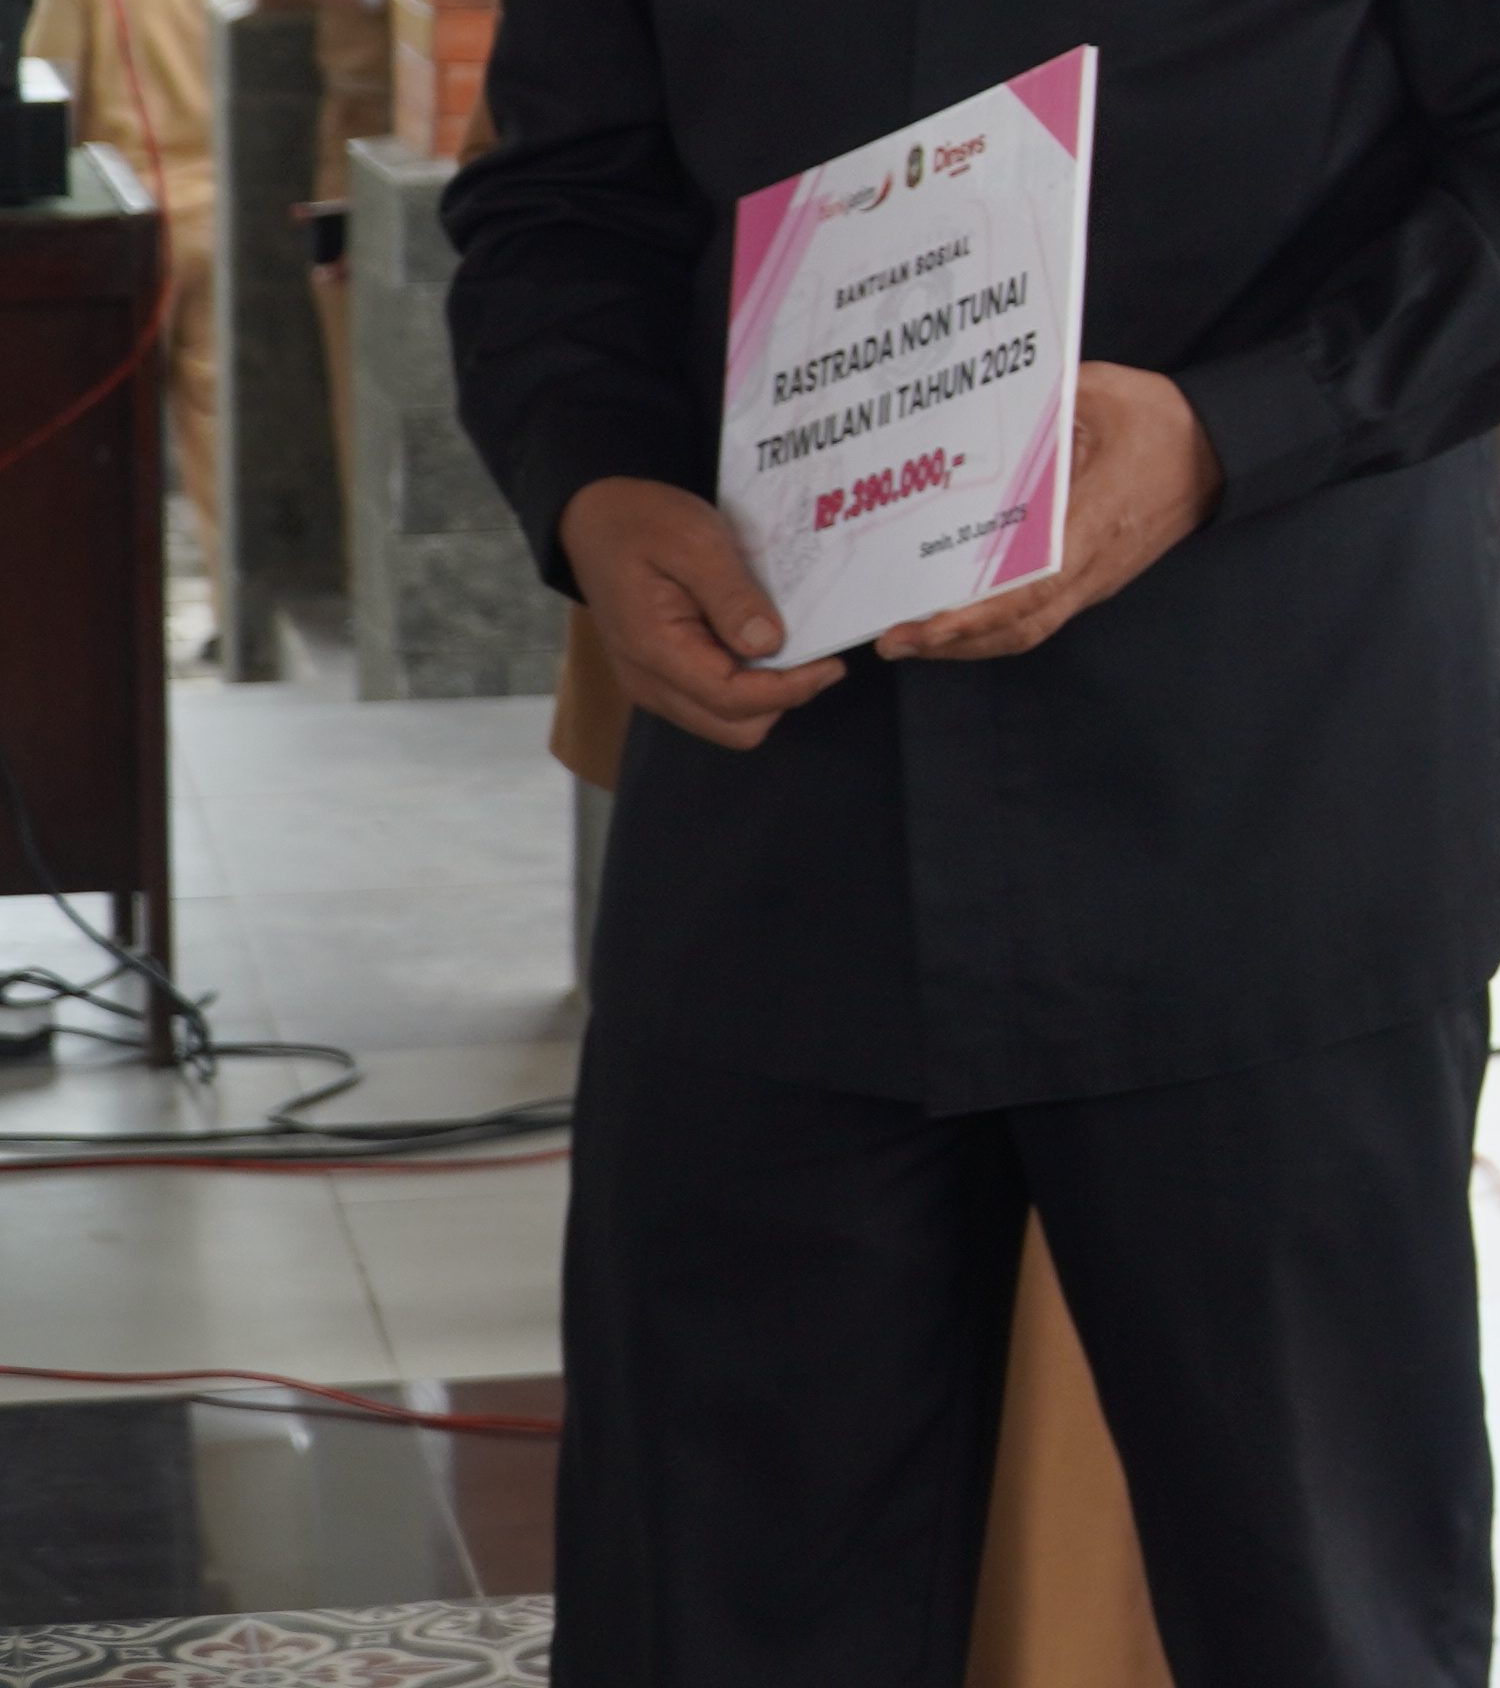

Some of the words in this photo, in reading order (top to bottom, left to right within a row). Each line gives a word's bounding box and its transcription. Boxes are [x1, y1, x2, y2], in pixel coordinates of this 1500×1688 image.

[773, 328, 895, 406] RASTRADA
[899, 304, 952, 356] NON
[956, 271, 1028, 331] TUNAI
[833, 260, 910, 310] BANTUAN
[914, 235, 971, 277] SOSIAL
[755, 398, 875, 473] TRIWULAN
[876, 391, 892, 428] II
[896, 357, 977, 419] TAHUN
[980, 330, 1038, 387] 2025
